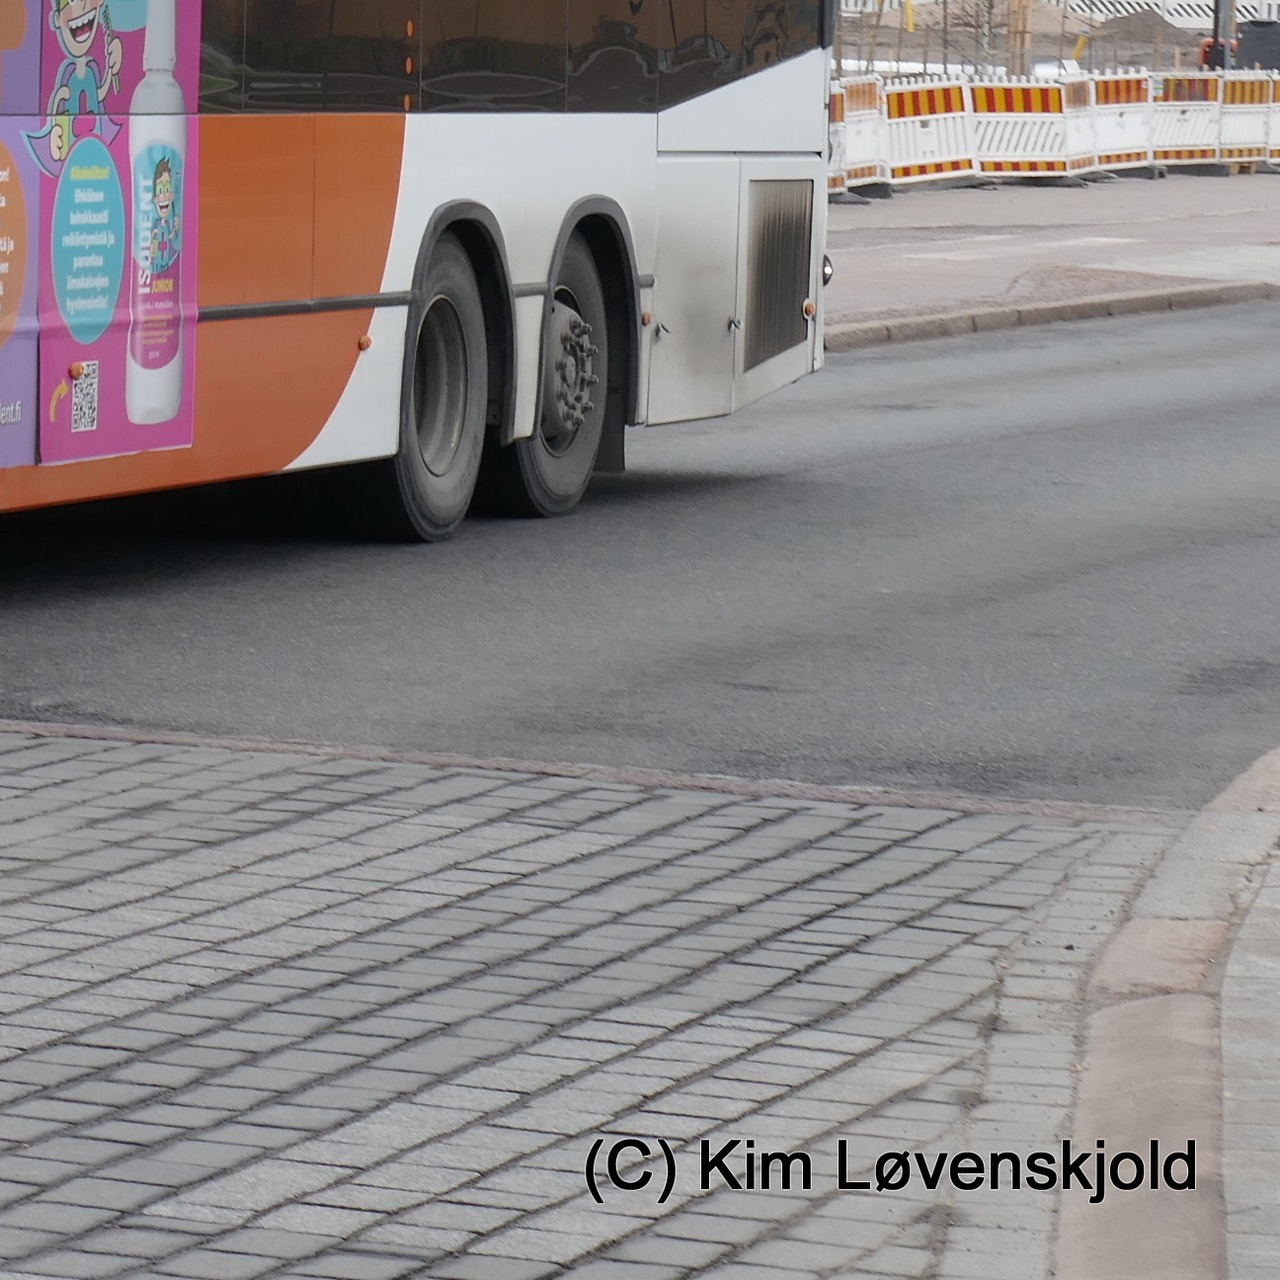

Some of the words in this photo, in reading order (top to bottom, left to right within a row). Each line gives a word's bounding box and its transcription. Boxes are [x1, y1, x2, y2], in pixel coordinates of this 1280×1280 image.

[138, 177, 152, 294] ISODENT
[73, 254, 103, 271] parantaa
[151, 279, 174, 293] JUNIOR
